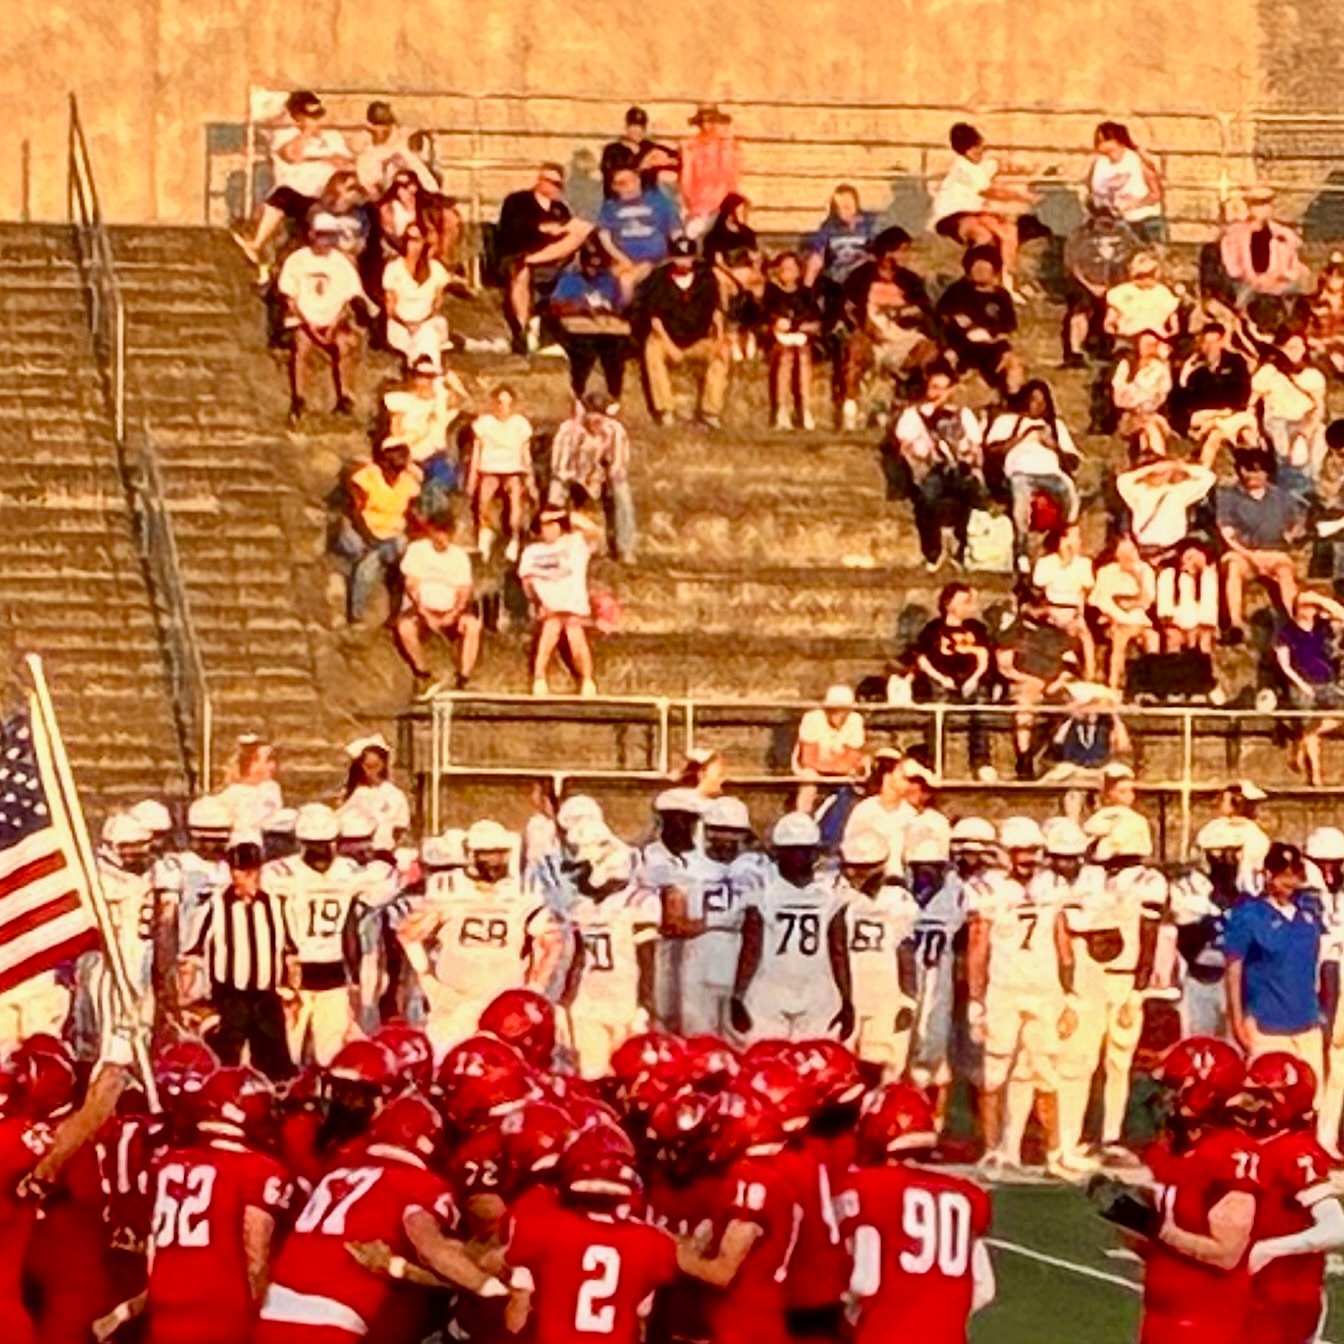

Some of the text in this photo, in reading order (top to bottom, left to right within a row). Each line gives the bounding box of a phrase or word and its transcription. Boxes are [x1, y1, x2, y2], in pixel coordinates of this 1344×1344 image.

[308, 899, 342, 938] 19
[775, 911, 821, 956] 78
[1017, 913, 1038, 951] 7
[899, 1186, 972, 1278] 90
[573, 1244, 622, 1334] 2
